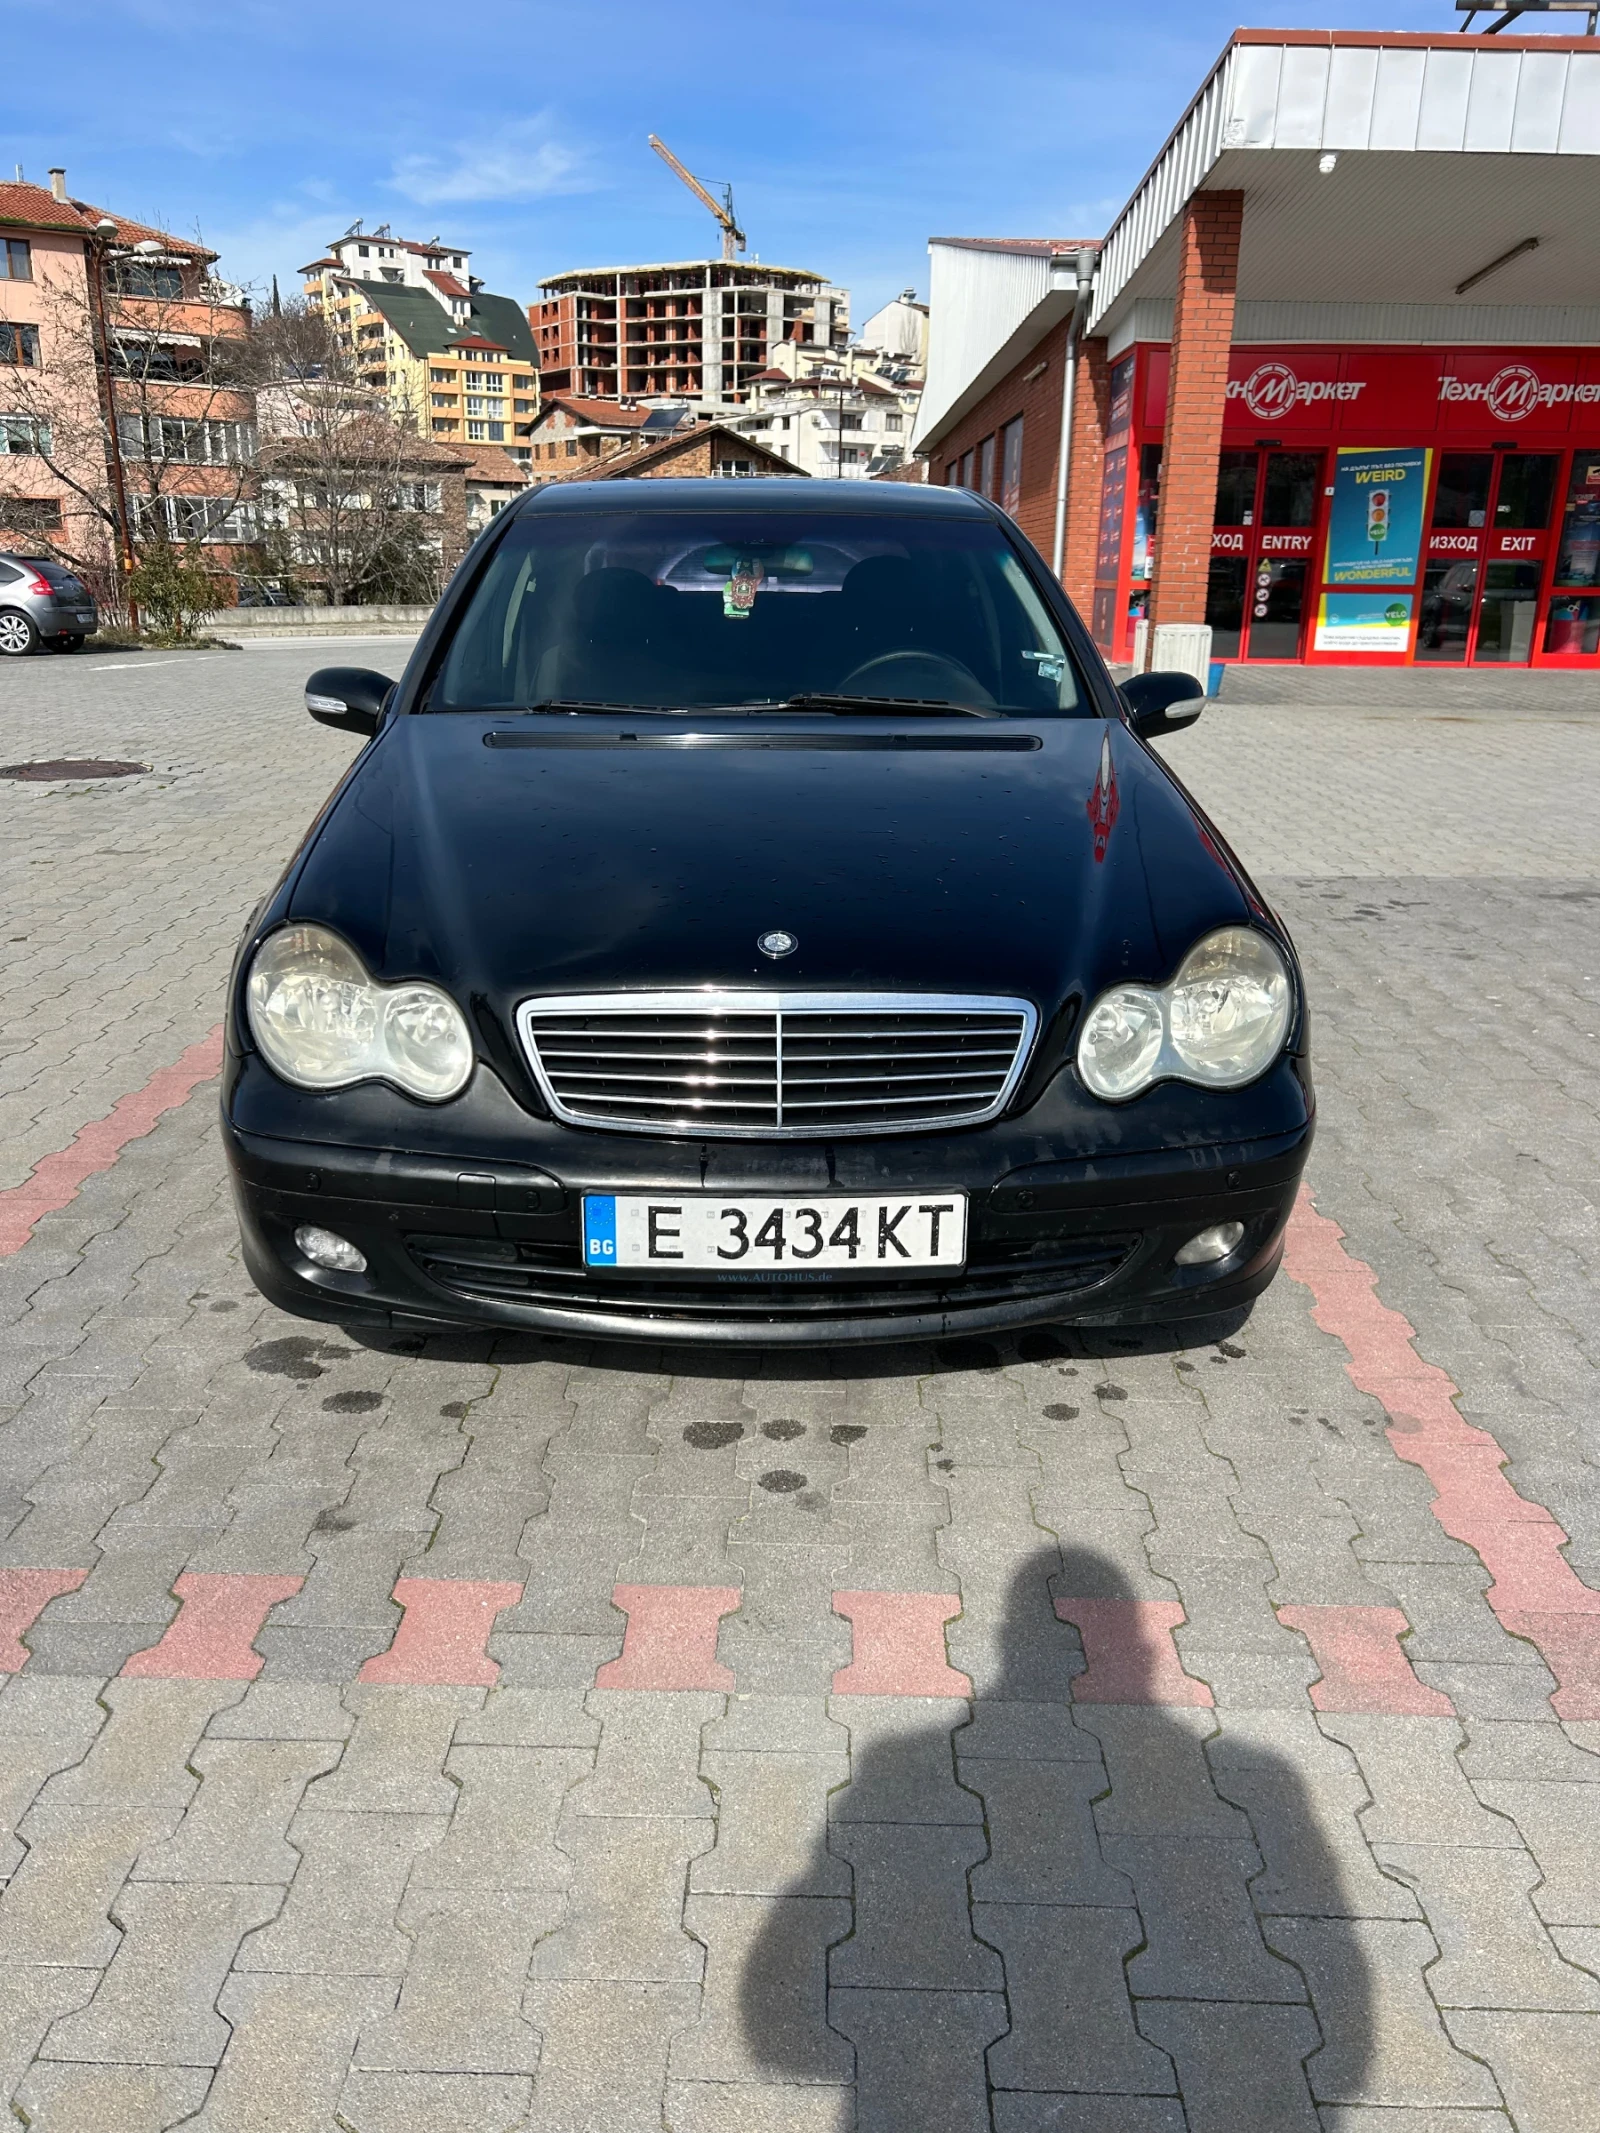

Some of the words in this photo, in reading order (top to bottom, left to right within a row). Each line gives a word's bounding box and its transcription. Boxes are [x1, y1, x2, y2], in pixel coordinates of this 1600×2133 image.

[1355, 469, 1406, 484] WEIRD
[1211, 534, 1244, 551] ХОД
[1262, 535, 1312, 550] ENTRY
[1429, 536, 1478, 552] ИЗХОД
[1501, 537, 1535, 551] EXIT
[1334, 567, 1412, 581] WONDERFUL
[1385, 610, 1407, 619] VELO
[648, 1205, 684, 1259] E
[589, 1238, 614, 1255] BG
[717, 1272, 833, 1283] www.AUTOHUS.de
